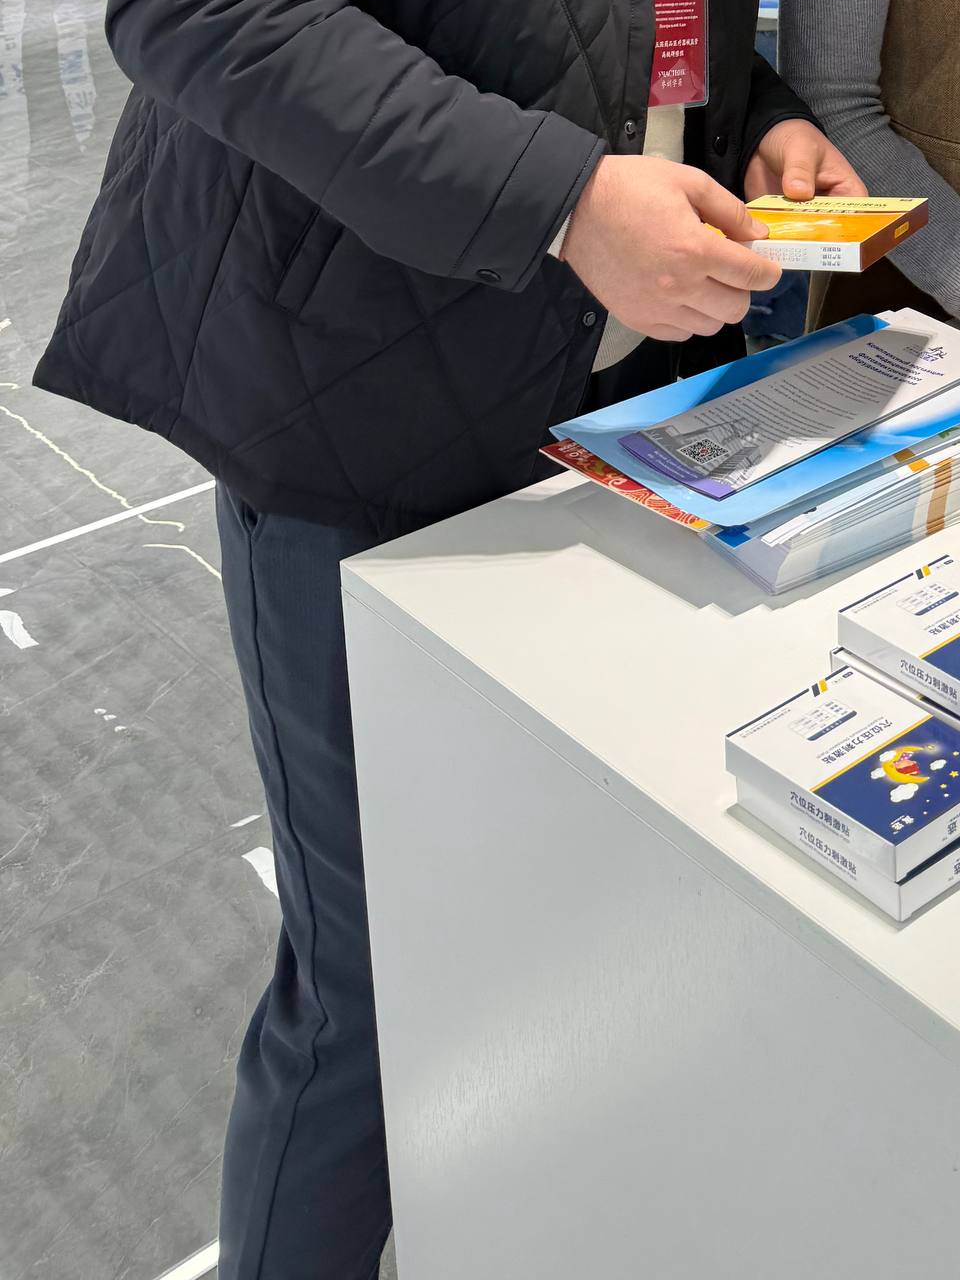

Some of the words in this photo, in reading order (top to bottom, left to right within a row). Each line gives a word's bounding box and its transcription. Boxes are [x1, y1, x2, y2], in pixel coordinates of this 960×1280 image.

[900, 658, 958, 700] 穴位压力刺激贴
[820, 719, 893, 764] 穴位压力刺激贴
[790, 791, 850, 837] 穴位压力刺激贴
[800, 826, 857, 875] 穴位压力刺激贴
